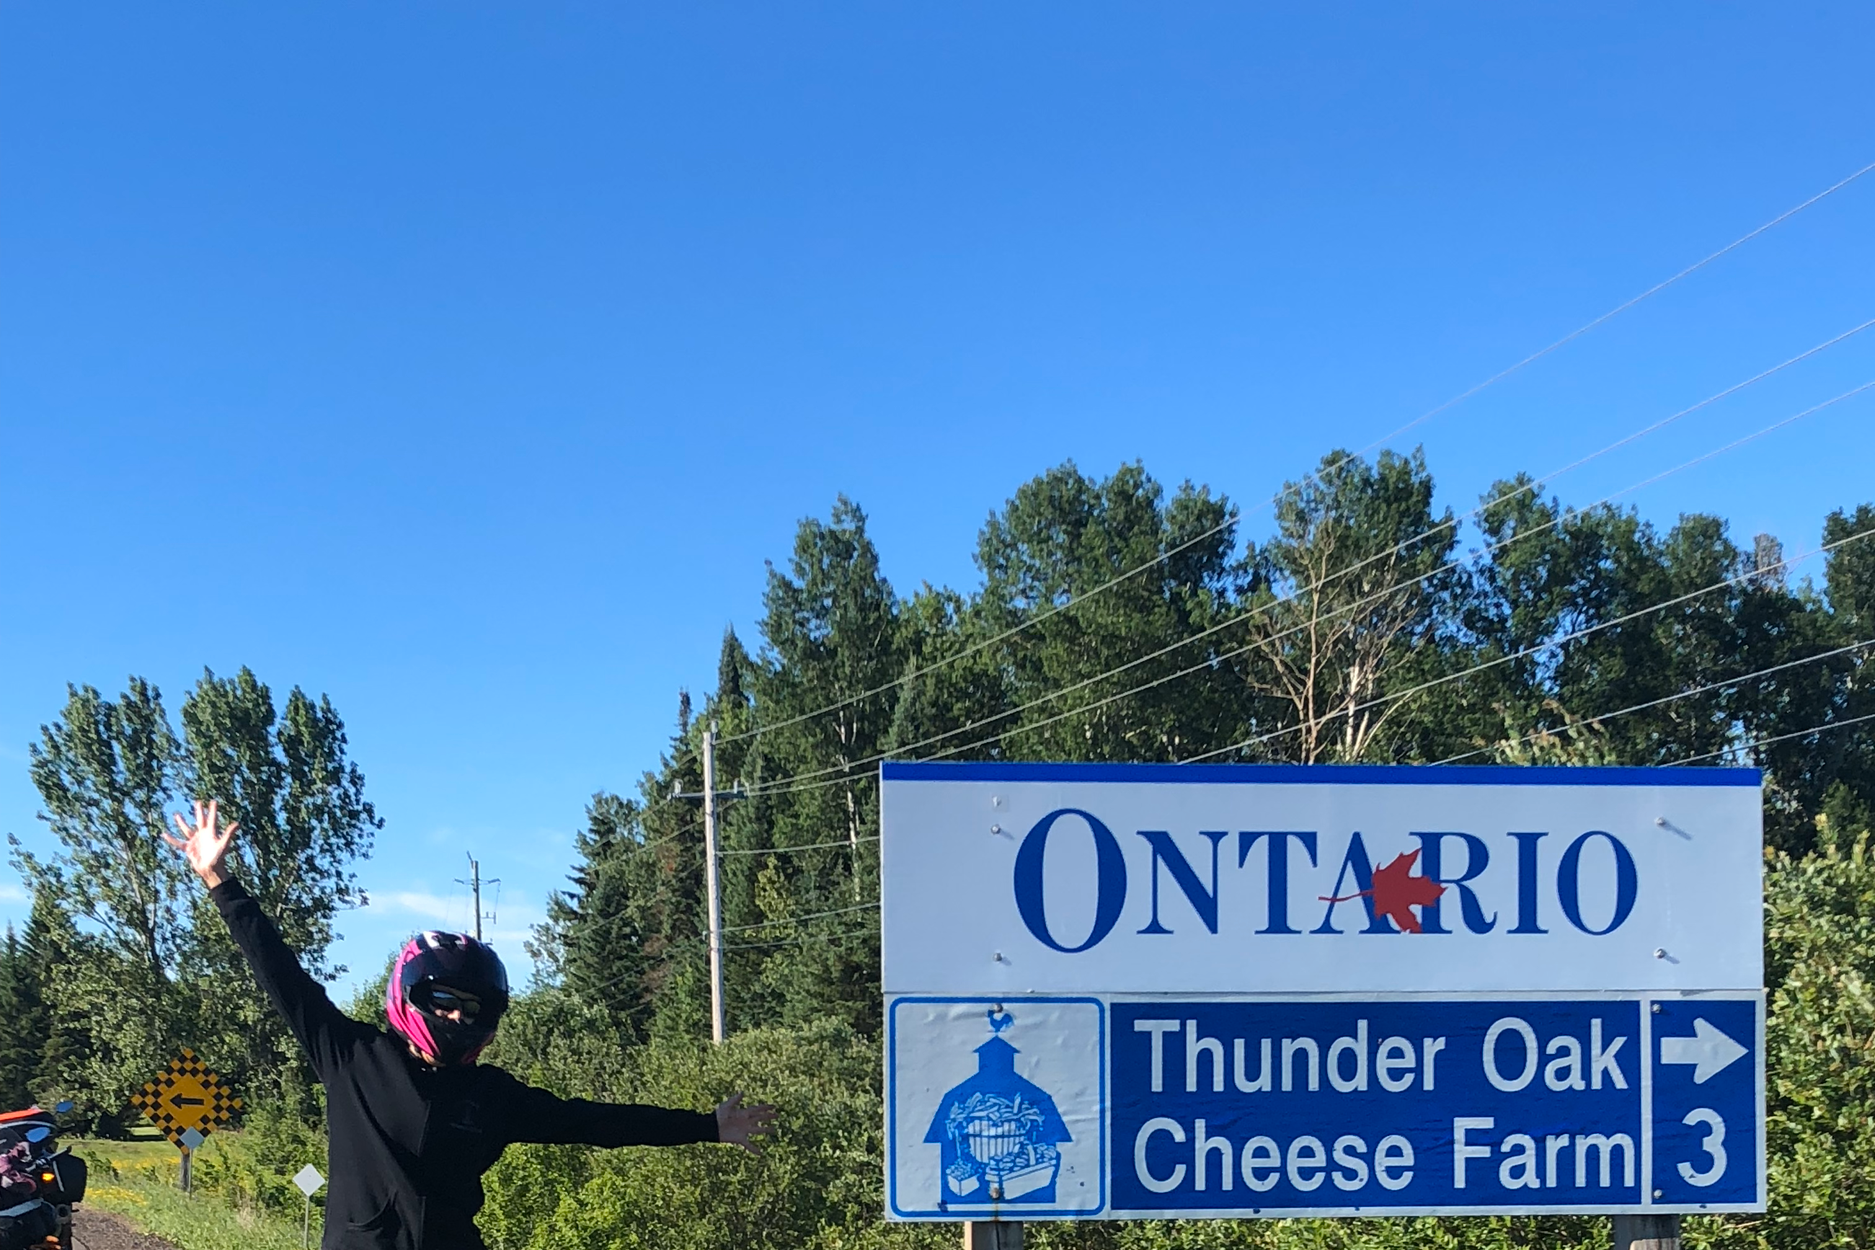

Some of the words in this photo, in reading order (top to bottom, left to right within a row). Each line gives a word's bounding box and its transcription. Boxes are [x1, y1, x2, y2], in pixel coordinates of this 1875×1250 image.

[1013, 807, 1639, 954] ONTARIO
[1133, 1018, 1446, 1093] Thunder
[1482, 1017, 1629, 1092] Oak
[1134, 1117, 1415, 1193] Cheese
[1453, 1116, 1636, 1190] Farm
[1676, 1107, 1727, 1187] 3
